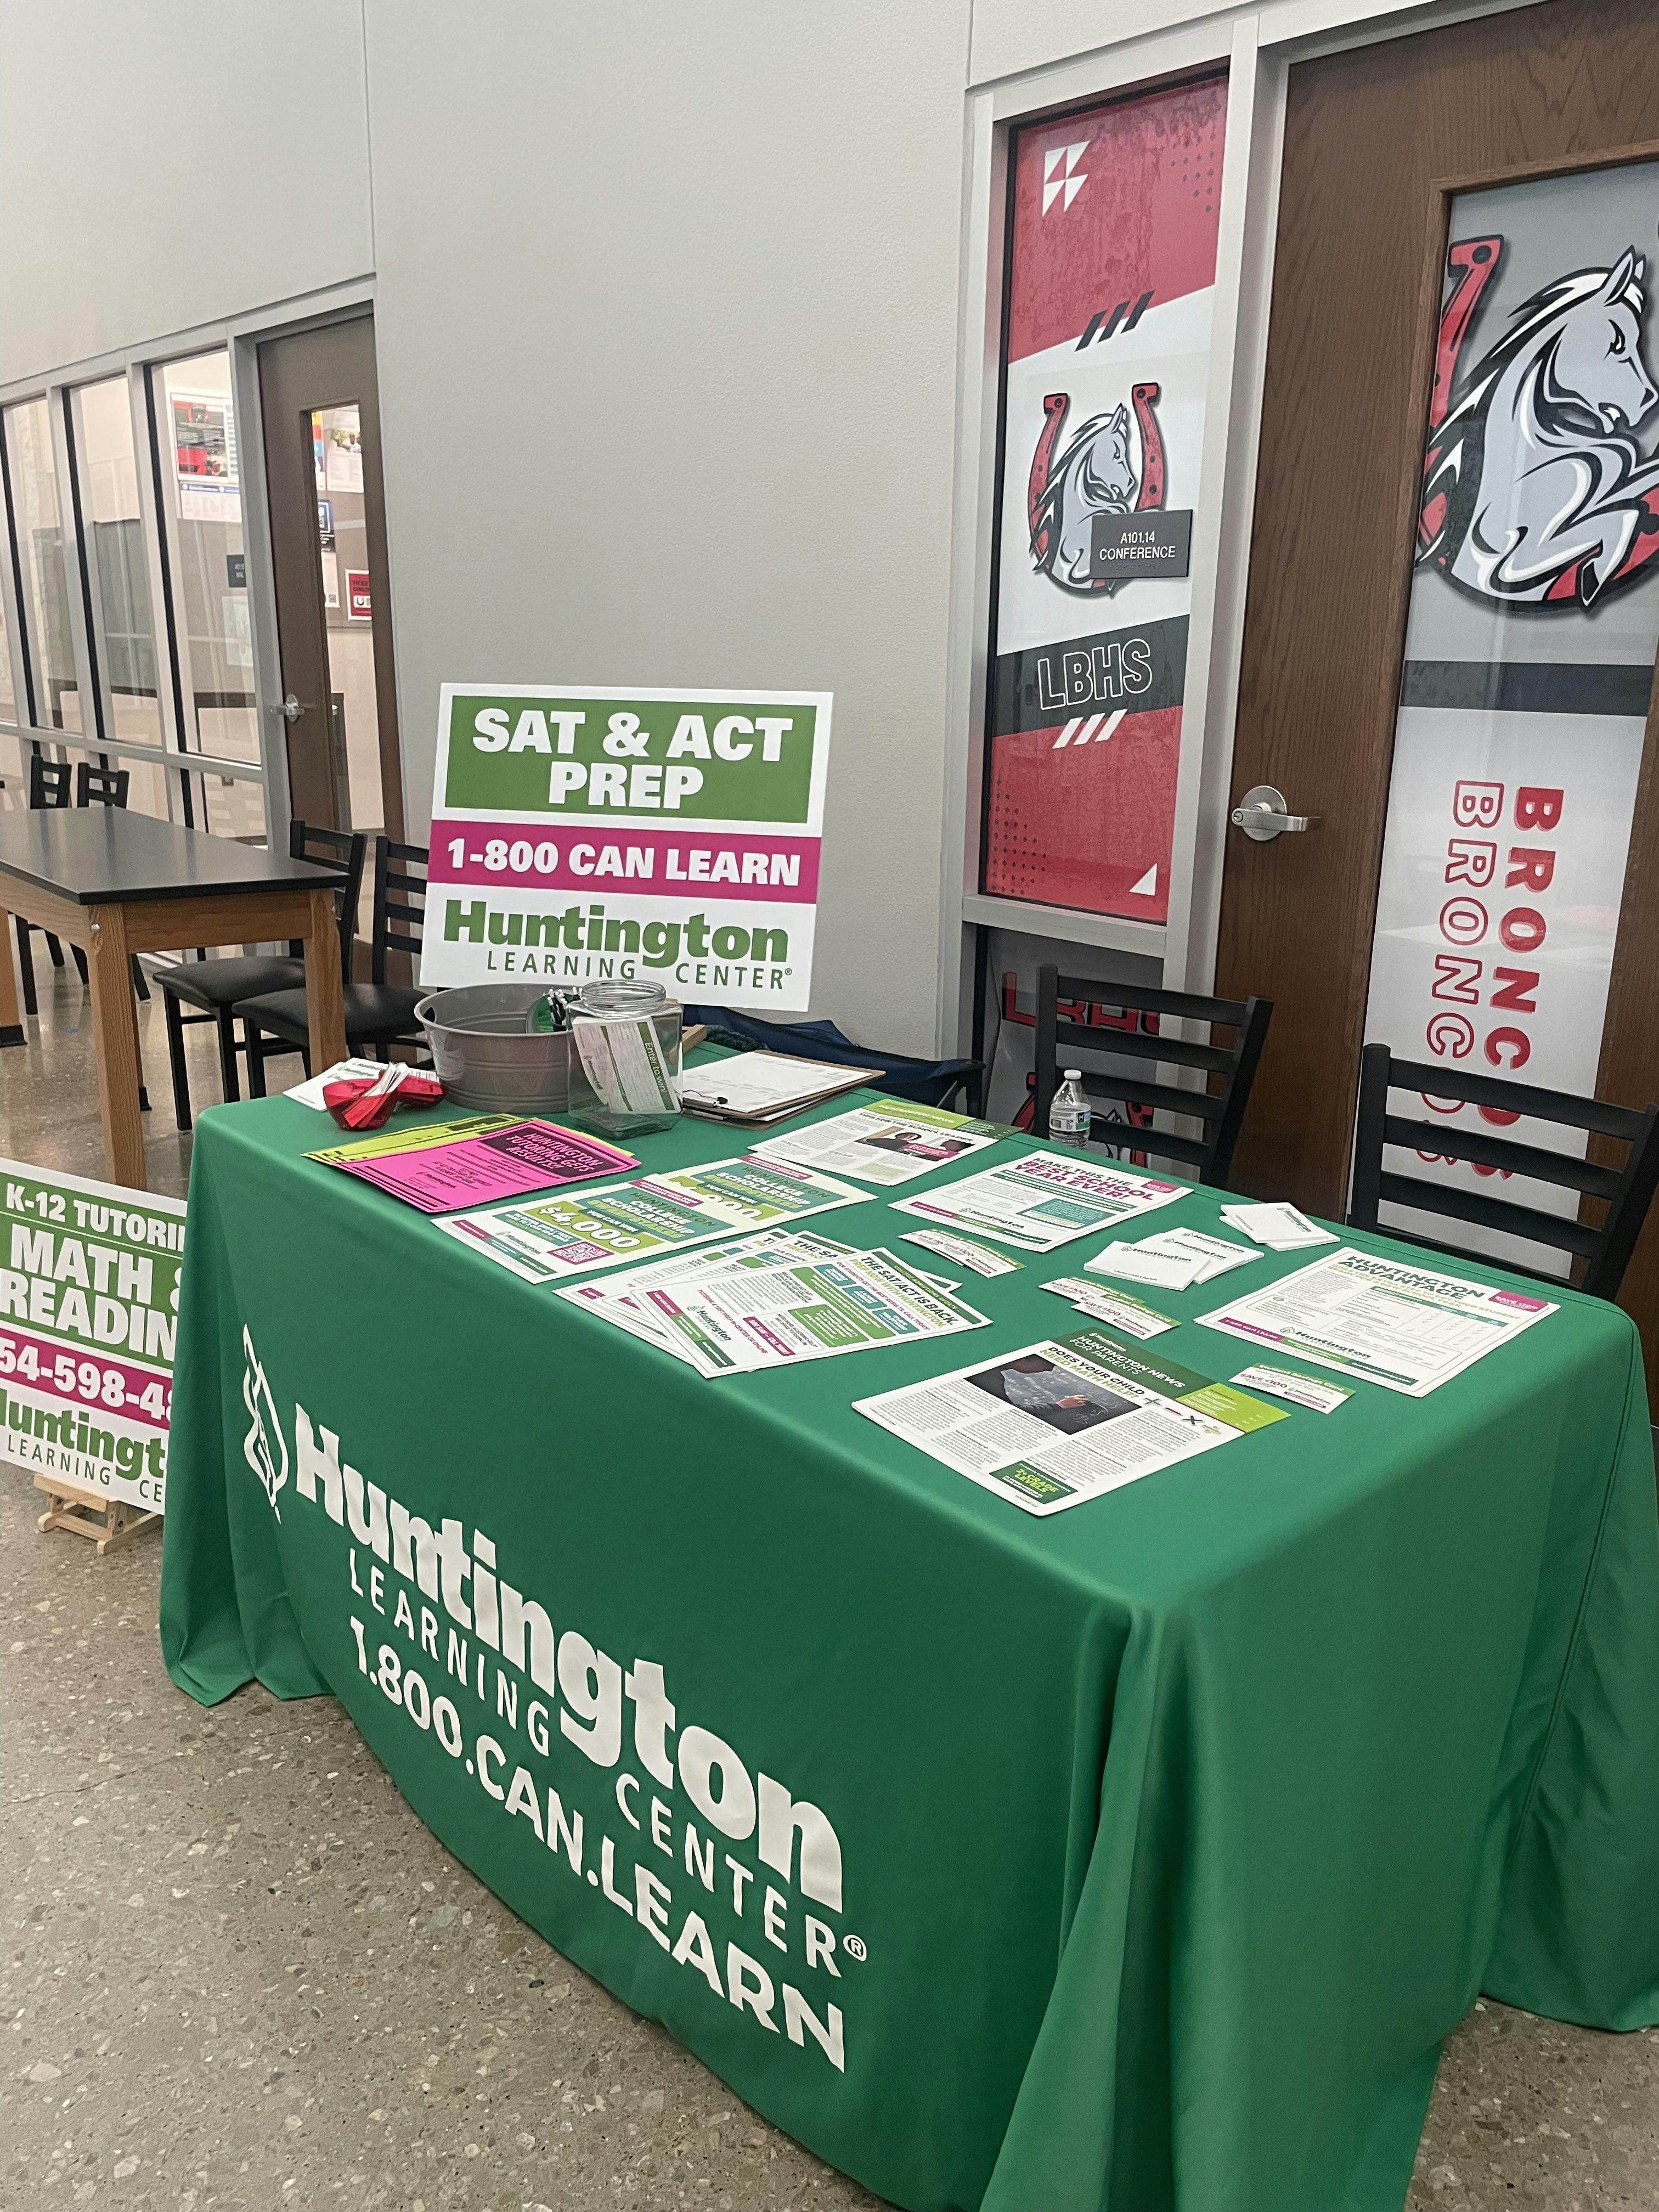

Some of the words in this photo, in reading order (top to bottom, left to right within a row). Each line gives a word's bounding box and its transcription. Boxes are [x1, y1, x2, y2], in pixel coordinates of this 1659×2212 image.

[1099, 546, 1176, 560] CONFERENCE
[1120, 531, 1155, 544] A101.14
[1037, 639, 1152, 710] LBHS
[473, 708, 585, 754] SAT
[602, 712, 650, 757] &
[667, 715, 793, 761] ACT
[549, 760, 703, 809] PREP
[447, 838, 558, 873] 1-800
[568, 844, 655, 879] CAN
[664, 848, 800, 887] LEARN
[443, 900, 788, 969] Huntington
[487, 951, 636, 979] LEARNING
[1416, 780, 1504, 1166] BRONC
[1470, 786, 1564, 1181] BRONC
[645, 1042, 658, 1065] Enter
[652, 1066, 661, 1075] to
[657, 1076, 668, 1093] win!
[522, 1132, 606, 1166] HUNTINGTON
[906, 1125, 940, 1133] SCHOOL
[939, 1132, 974, 1141] LEADER
[503, 1135, 569, 1161] TUTORING
[557, 1158, 596, 1172] GETS
[713, 1171, 814, 1206] SCHOLARSHIP
[738, 1166, 831, 1198] HUNTINGTON
[741, 1174, 808, 1197] COLLEGE
[1008, 1165, 1070, 1182] YEAR
[1063, 1180, 1132, 1199] EVER!
[1020, 1161, 1077, 1177] BEST
[1070, 1175, 1161, 1200] SCHOOL
[1030, 1158, 1075, 1170] MAKE
[1070, 1168, 1107, 1178] THIS
[1101, 1176, 1135, 1186] THE
[6, 1183, 65, 1222] K-12
[599, 1197, 698, 1235] SCHOLARSHIP
[627, 1192, 720, 1227] HUNTINGTON
[627, 1199, 694, 1225] COLLEGE
[736, 1195, 760, 1204] WIN
[532, 1204, 647, 1251] $4,000
[584, 1210, 607, 1218] YOU
[600, 1216, 623, 1225] CAN
[616, 1223, 641, 1232] WIN
[967, 1210, 1028, 1229] Huntington
[783, 1244, 809, 1253] PREP
[794, 1240, 822, 1252] THE
[1133, 1248, 1192, 1262] Huntington
[1173, 1241, 1227, 1259] Huntington
[1193, 1234, 1245, 1253] Huntington
[11, 1223, 153, 1305] MATH
[1335, 1260, 1469, 1300] ADVANTAGE
[1344, 1256, 1487, 1298] HUNTINGTON
[847, 1259, 871, 1271] PREP
[863, 1271, 887, 1283] NOW
[879, 1282, 904, 1295] WITH
[895, 1294, 950, 1328] HUNTINGTON.
[857, 1256, 887, 1271] THE
[874, 1269, 923, 1297] SAT/ACT
[912, 1296, 932, 1304] IS
[922, 1303, 962, 1325] BACK.
[1119, 1292, 1136, 1301] Card
[1324, 1266, 1356, 1276] READY
[1400, 1288, 1437, 1300] SCHOOL
[1436, 1299, 1463, 1307] YEAR
[1329, 1264, 1355, 1272] GOES
[1370, 1276, 1401, 1286] EXTRA
[1452, 1299, 1479, 1308] YOUR
[1477, 1306, 1521, 1321] STUDENT
[693, 1310, 735, 1342] Huntington
[697, 1289, 716, 1304] TUTORING
[721, 1313, 734, 1321] PREP
[729, 1321, 751, 1337] IN-CENTER
[751, 1341, 769, 1354] ONLINE
[1085, 1301, 1103, 1310] SAVE
[1103, 1307, 1121, 1316] $100
[1155, 1313, 1171, 1322] Card
[1223, 1319, 1245, 1327] 1-800
[1254, 1330, 1279, 1339] LEARN
[1292, 1331, 1374, 1359] Huntington
[1037, 1349, 1075, 1366] NEED
[1066, 1364, 1107, 1382] MATH
[1099, 1380, 1141, 1399] HELP?
[1045, 1346, 1082, 1363] DOES
[1075, 1361, 1114, 1379] YOUR
[1107, 1377, 1147, 1395] CHILD
[1066, 1339, 1095, 1351] FOR
[1088, 1350, 1145, 1375] PARENTS
[1073, 1336, 1154, 1371] HUNTINGTON
[1145, 1369, 1188, 1388] NEWS
[0, 1343, 173, 1422] 54-598-4
[1239, 1373, 1262, 1381] SAVE
[1265, 1379, 1288, 1388] $100
[1259, 1364, 1290, 1374] Student
[1291, 1372, 1323, 1384] Savings
[1324, 1381, 1345, 1391] Card
[0, 1388, 167, 1480] untingt
[8, 1434, 110, 1486] LEARNING
[1013, 1473, 1049, 1493] LEVELS
[1025, 1474, 1060, 1492] GRADE
[295, 1402, 845, 1915] Huntington
[348, 1548, 550, 1757] LEARNING
[350, 1615, 846, 2073] 1.800.CAN.LEARN
